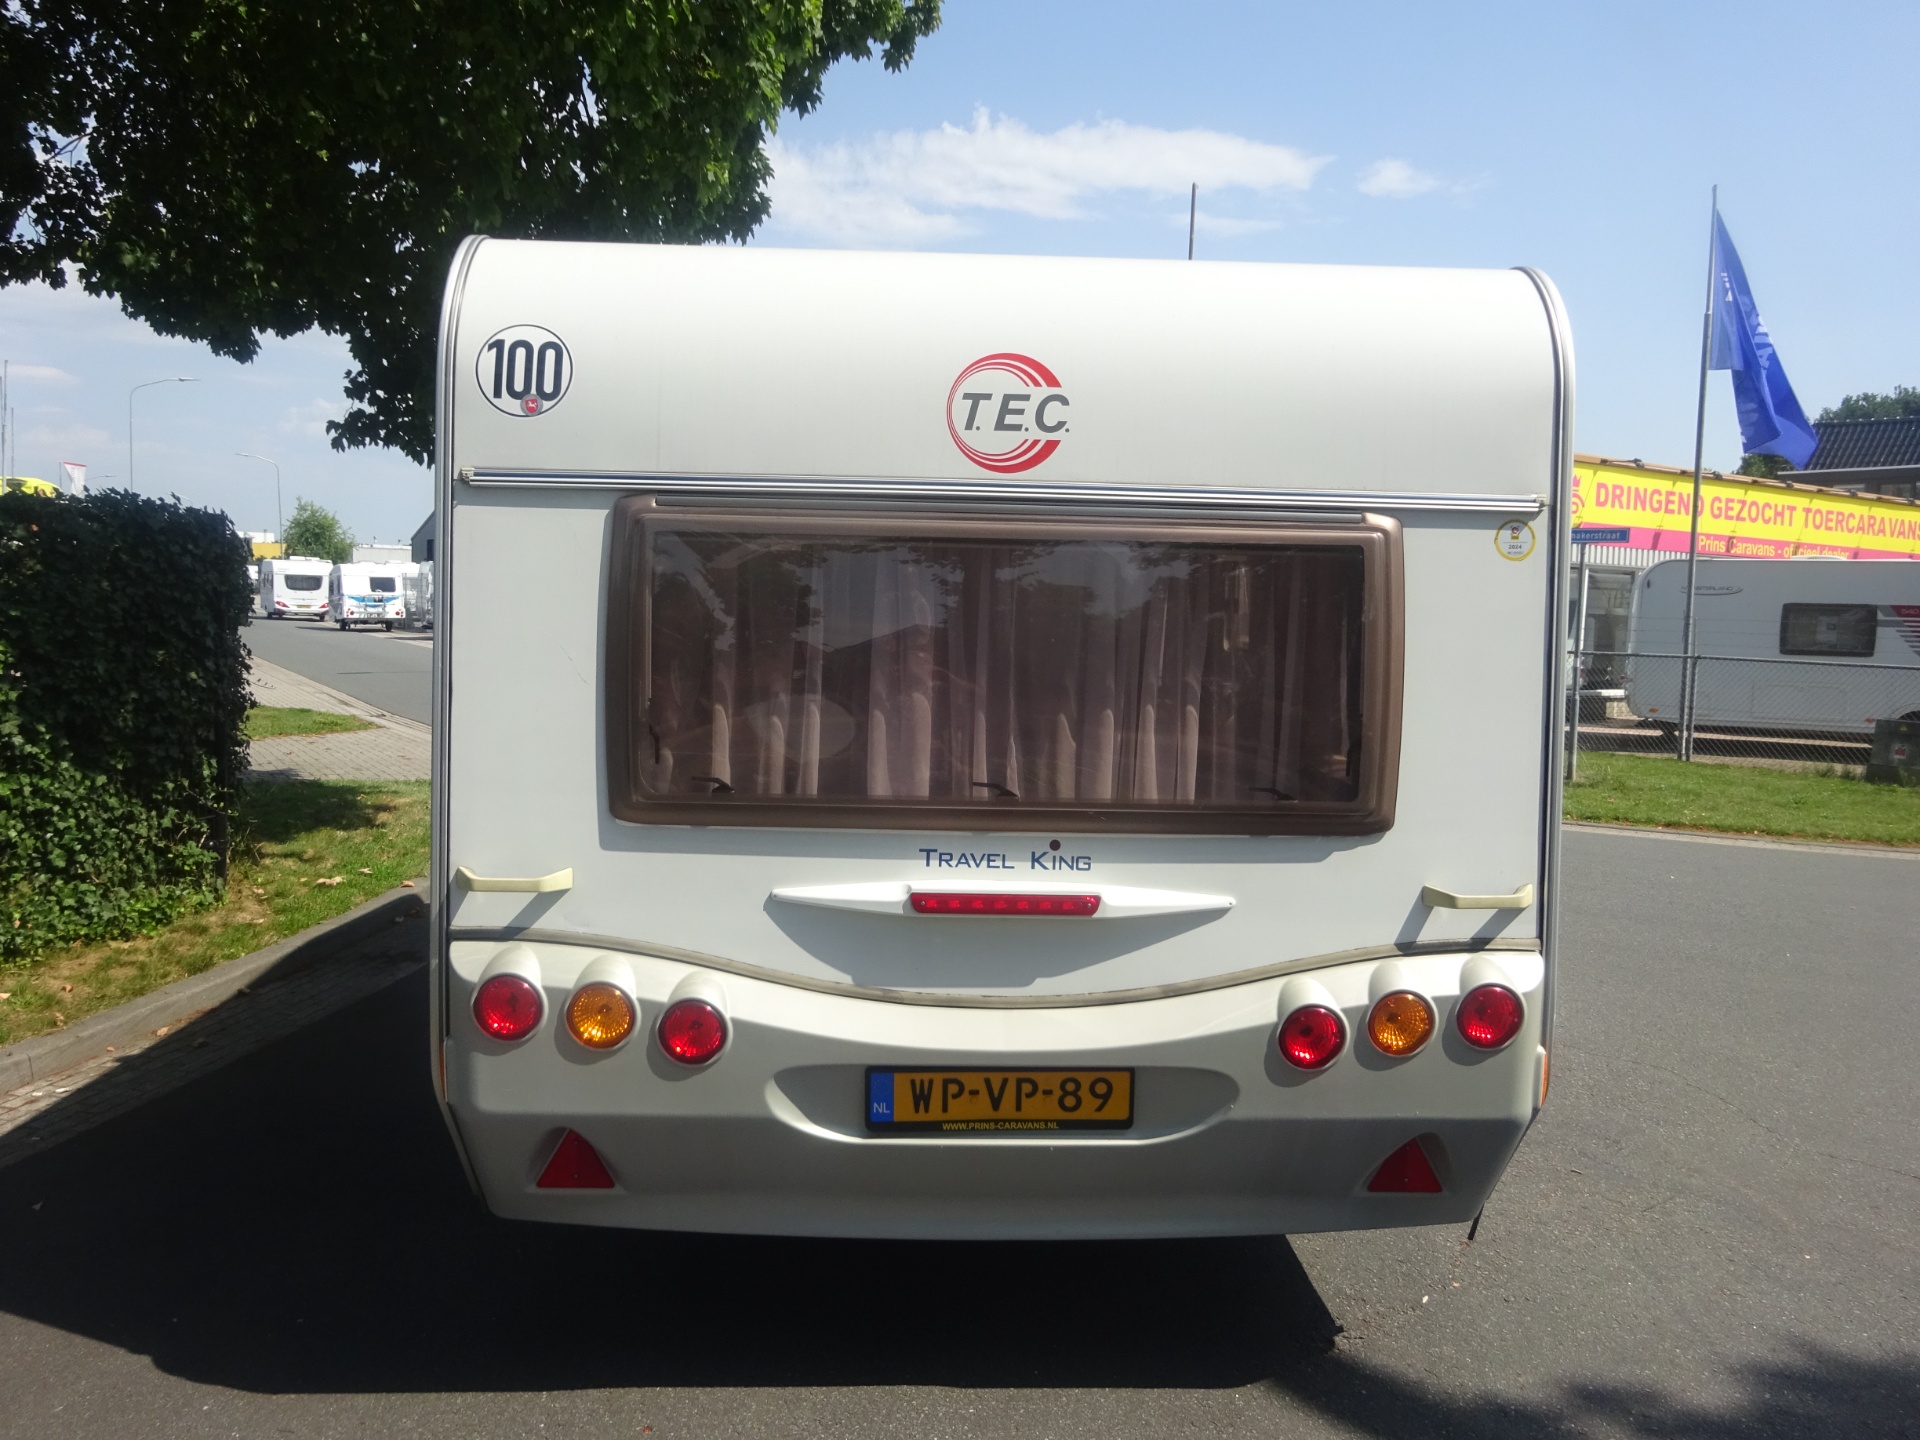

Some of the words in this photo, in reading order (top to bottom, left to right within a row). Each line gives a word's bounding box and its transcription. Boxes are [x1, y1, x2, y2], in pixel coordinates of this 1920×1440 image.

[487, 338, 563, 401] 100
[960, 392, 1070, 433] T.E.C.
[1710, 496, 1797, 527] GEZOCHT
[1698, 535, 1726, 553] Prins
[1728, 538, 1775, 557] Caravans
[1783, 543, 1820, 558] ofcieel
[919, 848, 1015, 870] TRAVEL
[873, 1103, 890, 1113] NL
[910, 1077, 1114, 1114] WP-VP-89
[942, 1121, 1059, 1131] WWW.PRINS-CARAVANS.NL
